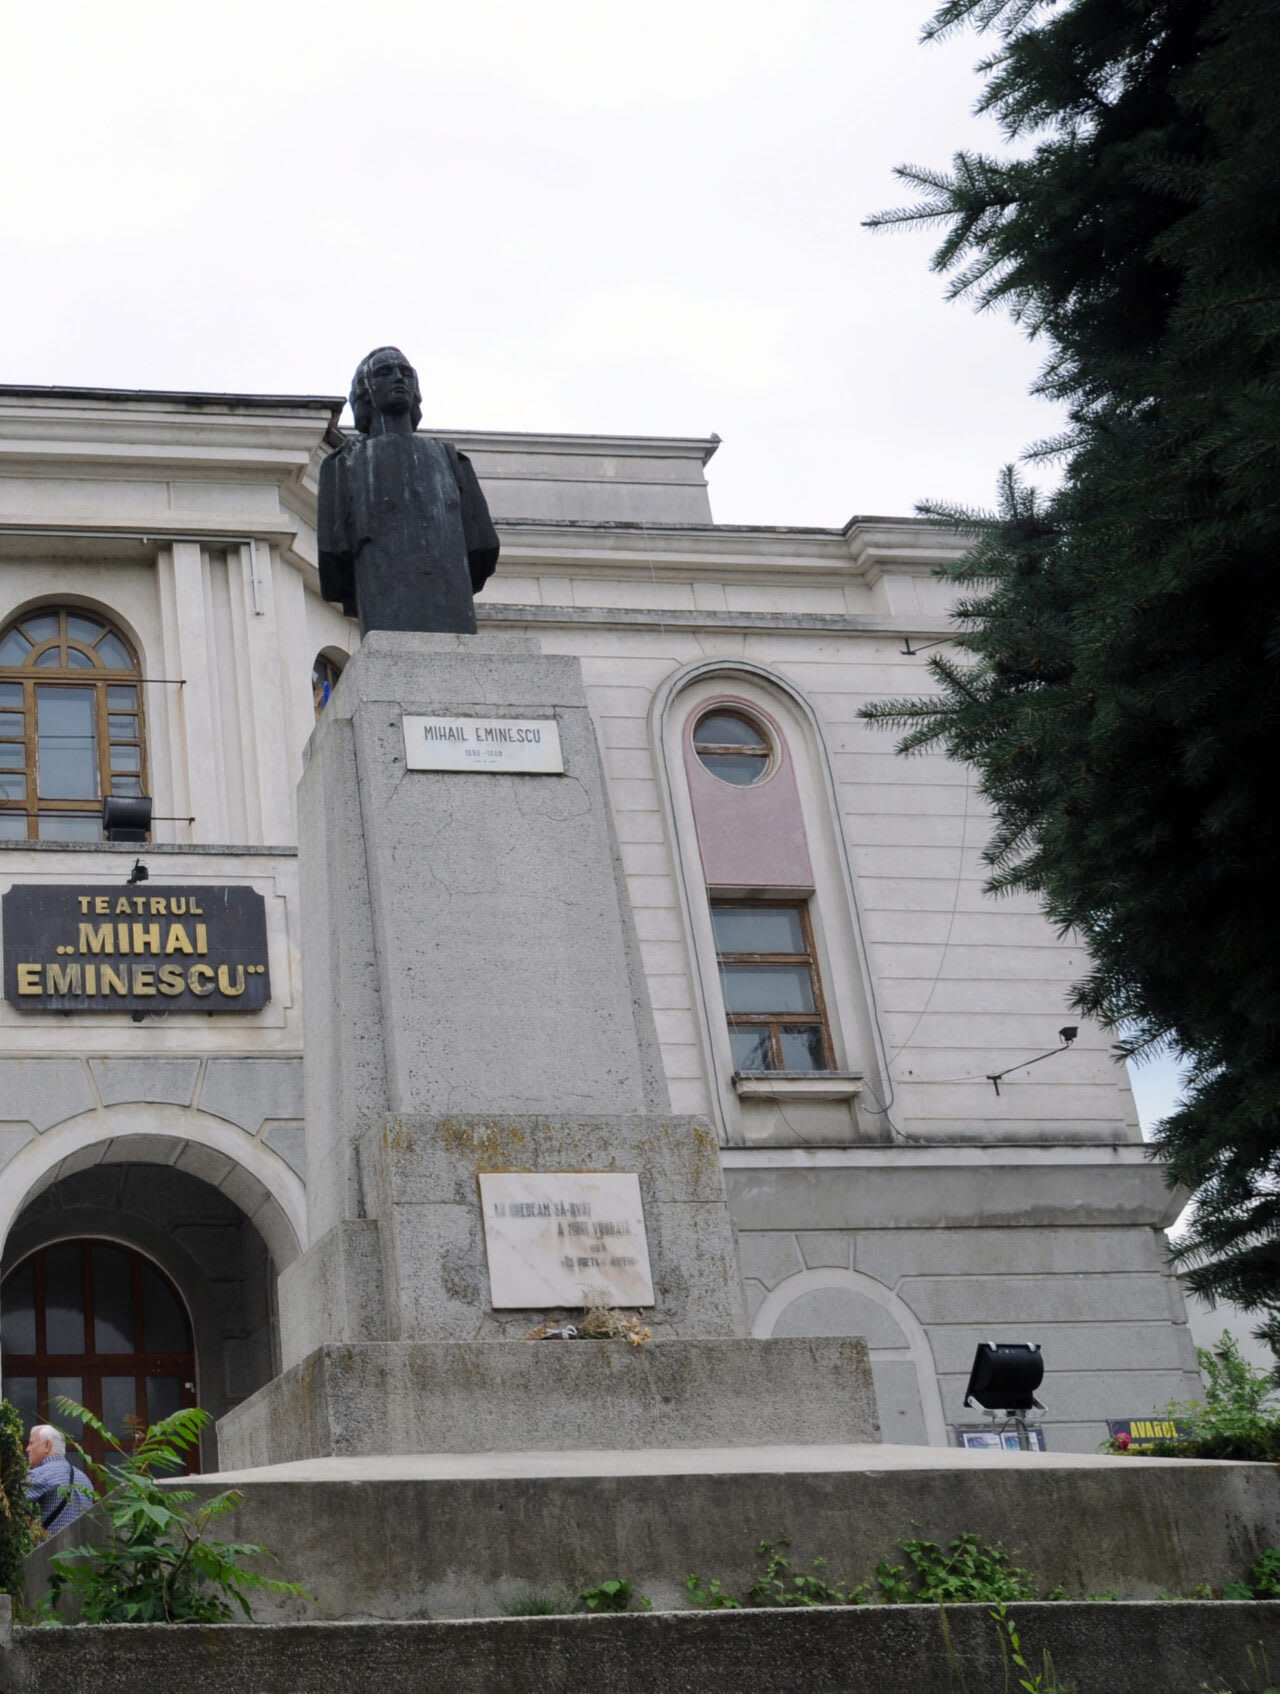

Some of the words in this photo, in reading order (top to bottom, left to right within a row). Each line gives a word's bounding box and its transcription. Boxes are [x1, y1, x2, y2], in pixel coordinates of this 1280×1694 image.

[424, 726, 468, 741] MIHAIL
[476, 727, 541, 743] EMINESCU
[78, 896, 203, 915] TEATRUL
